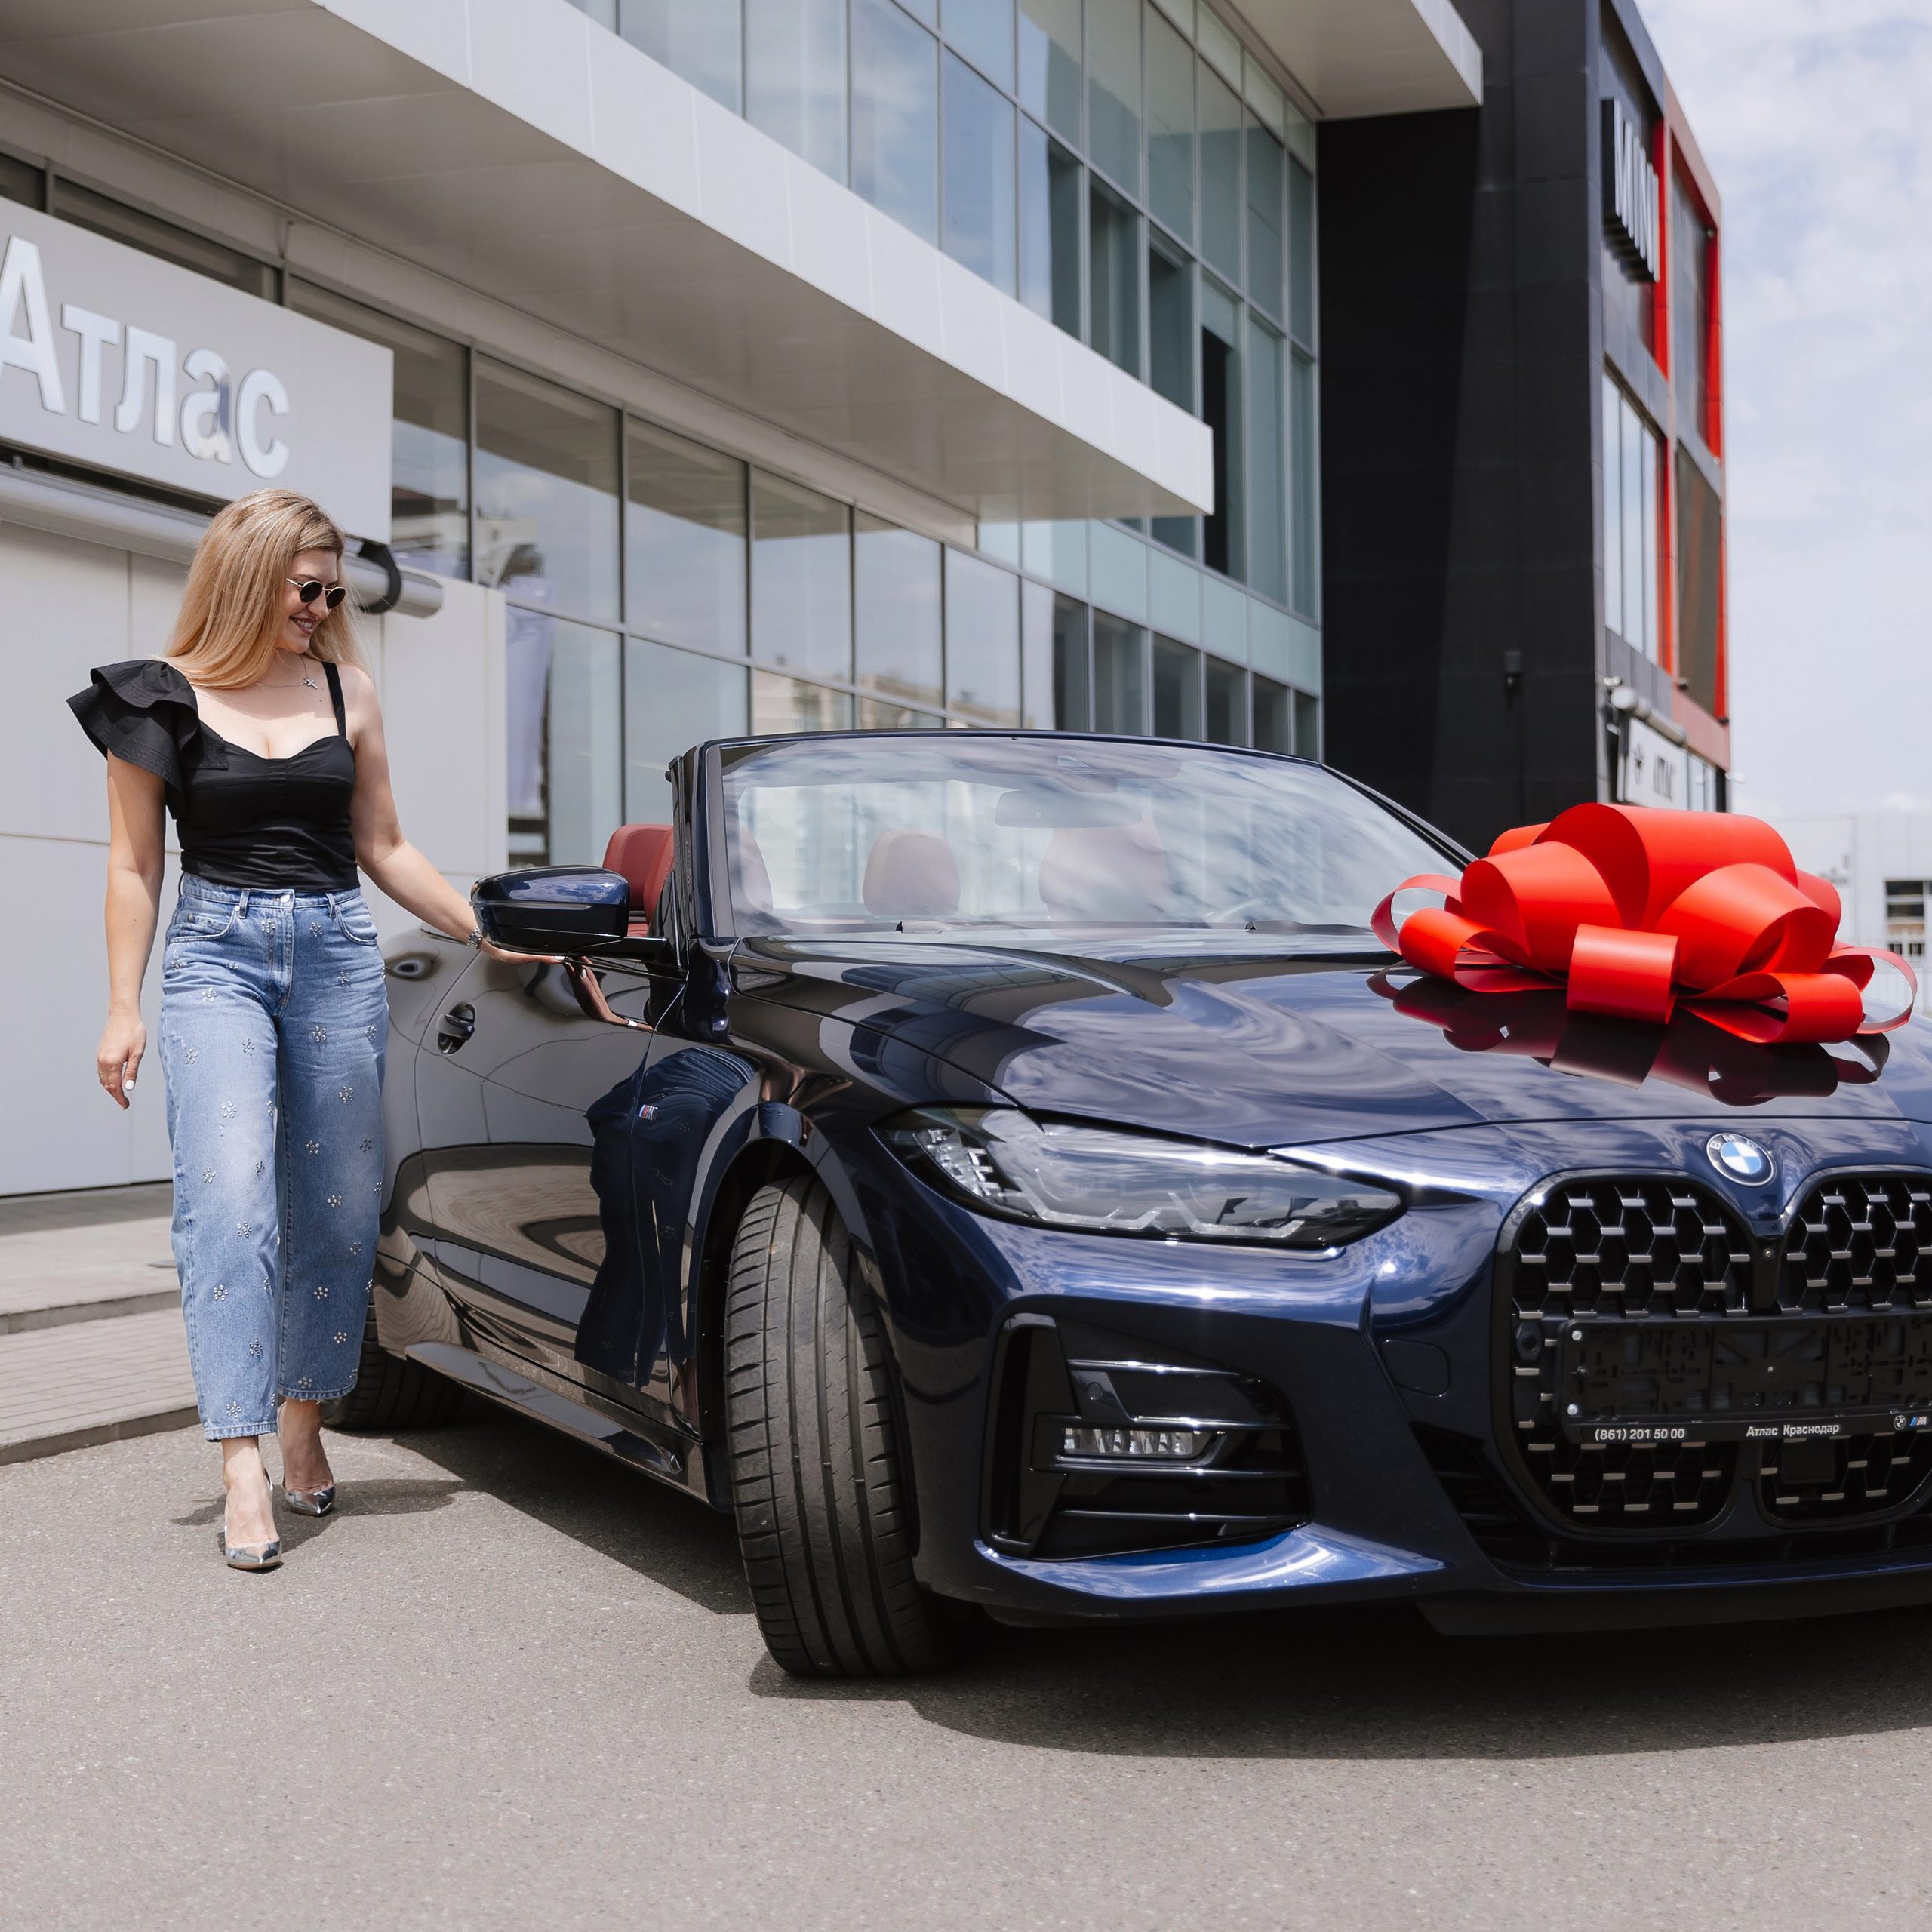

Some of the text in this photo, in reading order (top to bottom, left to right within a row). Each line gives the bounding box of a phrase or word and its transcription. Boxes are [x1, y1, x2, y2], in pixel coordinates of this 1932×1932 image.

[0, 235, 290, 479] Атлас
[1709, 1134, 1758, 1150] BMW
[1595, 1428, 1684, 1441] (861) 201 50 00
[1746, 1424, 1840, 1437] Атлас Краснодар
